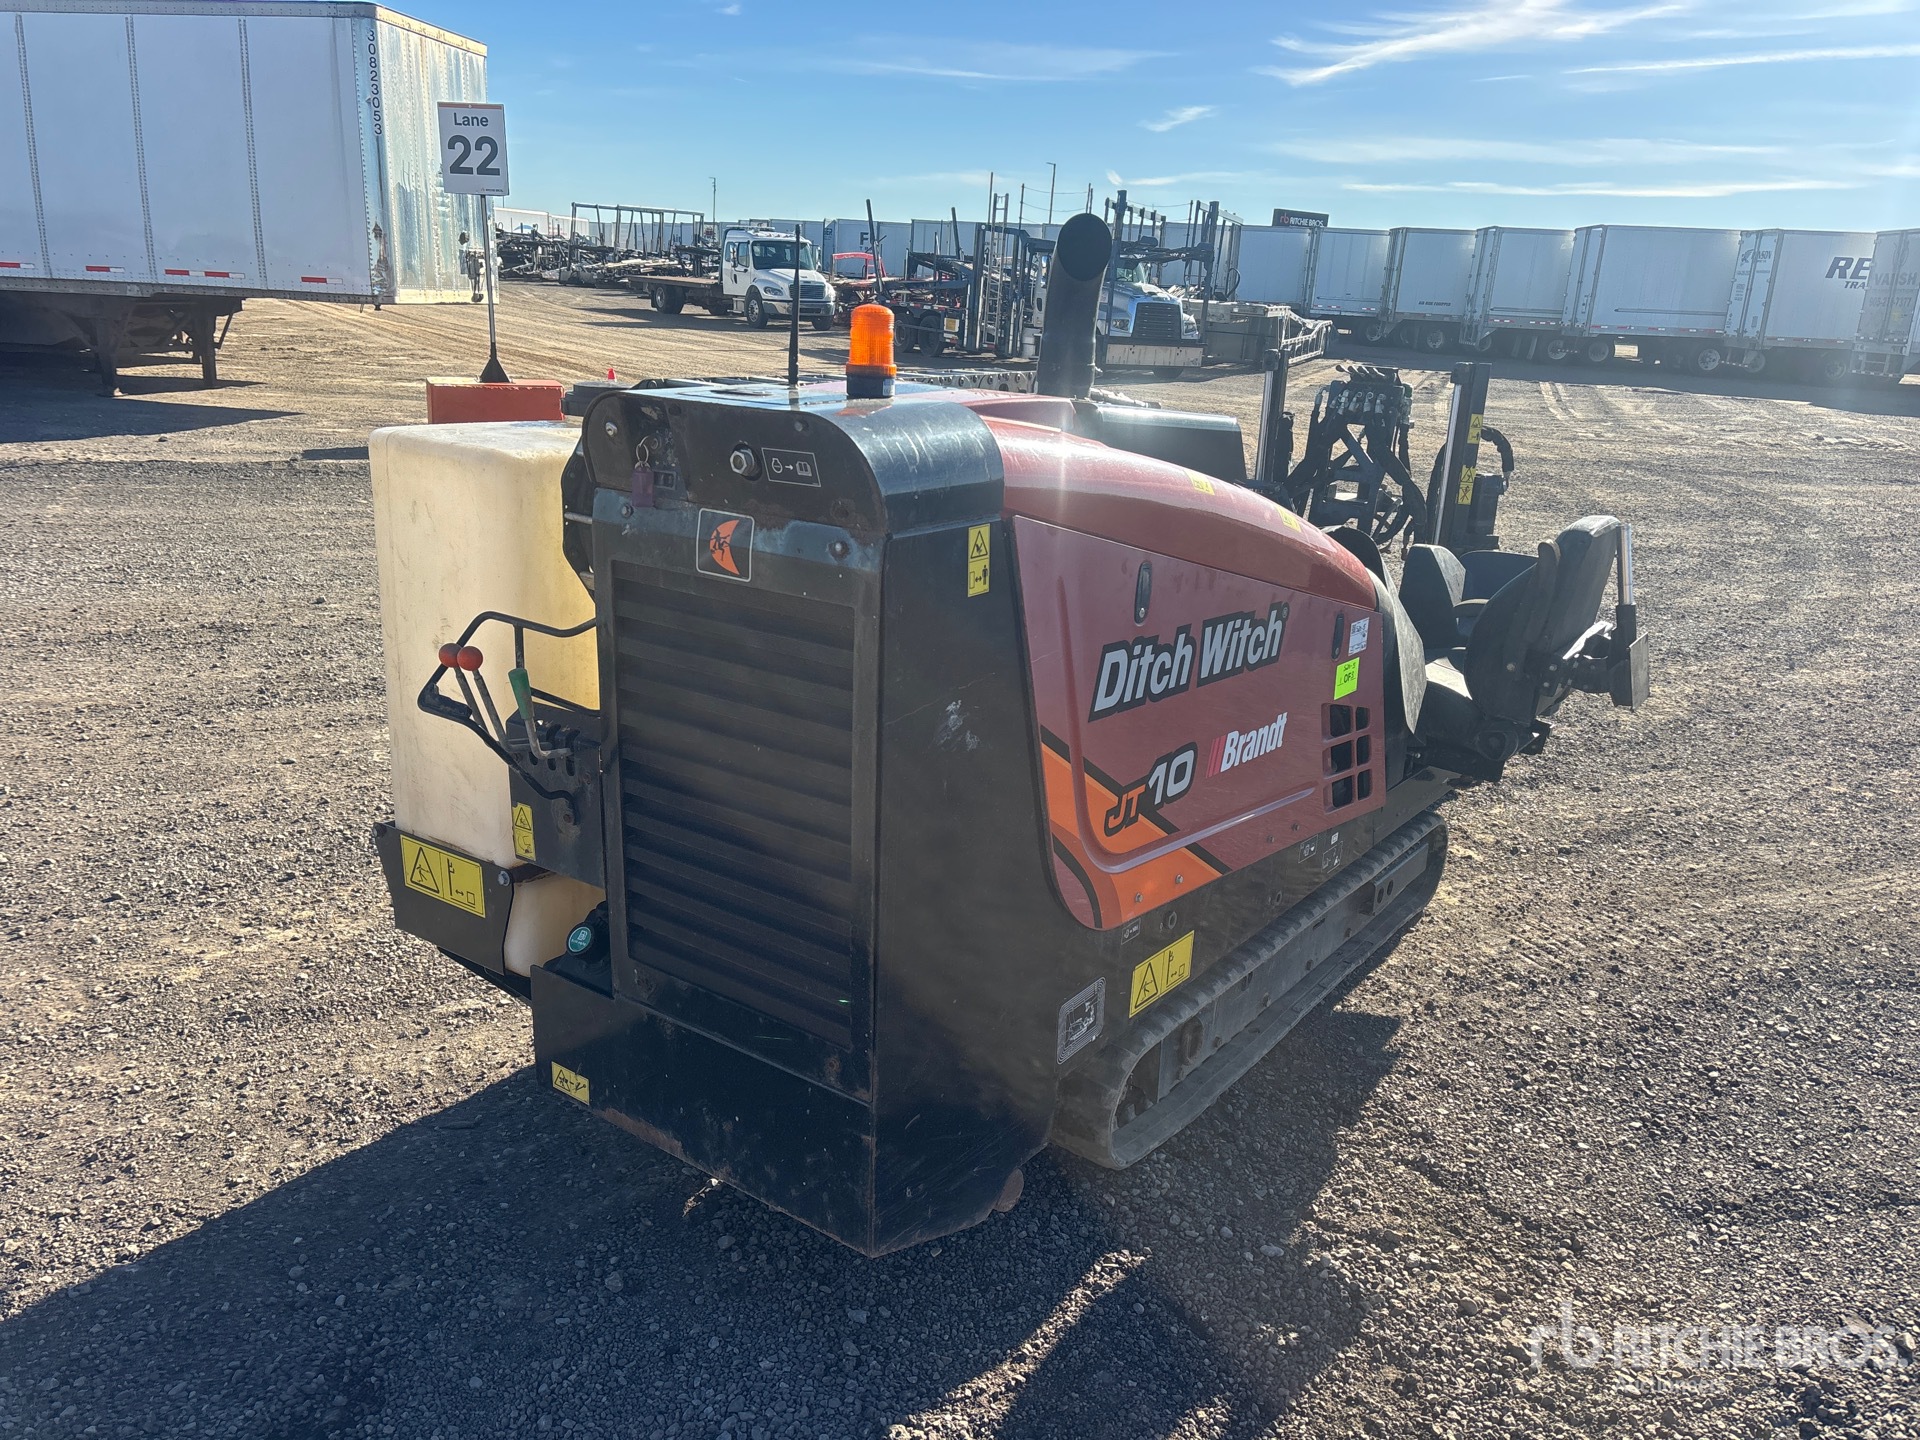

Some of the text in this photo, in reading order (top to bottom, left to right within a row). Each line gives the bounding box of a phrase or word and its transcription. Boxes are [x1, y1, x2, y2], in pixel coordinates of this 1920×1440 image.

[367, 29, 382, 135] 30823053
[453, 112, 489, 127] Lane
[447, 134, 500, 176] 22
[1290, 216, 1308, 226] RITCHIE
[1093, 609, 1284, 713] Ditch Witch
[1220, 711, 1288, 772] Brandt
